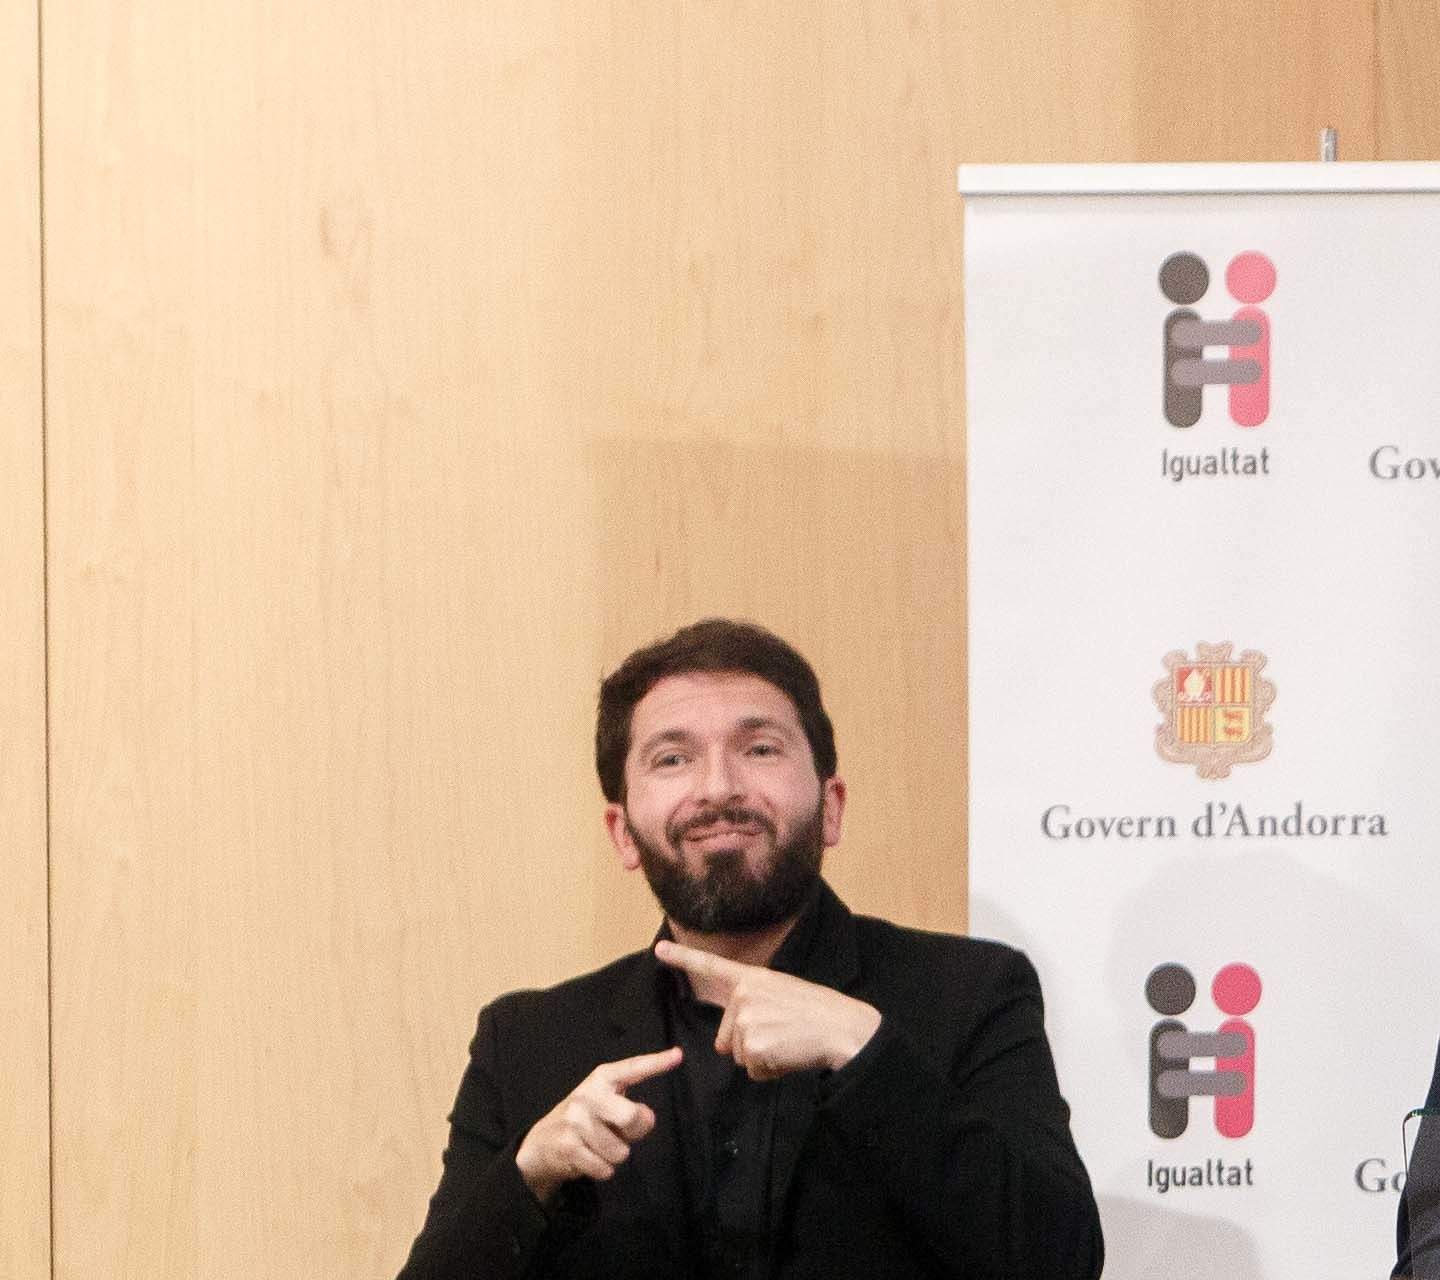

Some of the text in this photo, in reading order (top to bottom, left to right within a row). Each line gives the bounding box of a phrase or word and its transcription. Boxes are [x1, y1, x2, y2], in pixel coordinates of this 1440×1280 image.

[1162, 447, 1271, 483] Igualtat
[1040, 801, 1390, 840] Govern d'Andorra
[1146, 1159, 1255, 1195] Igualtat
